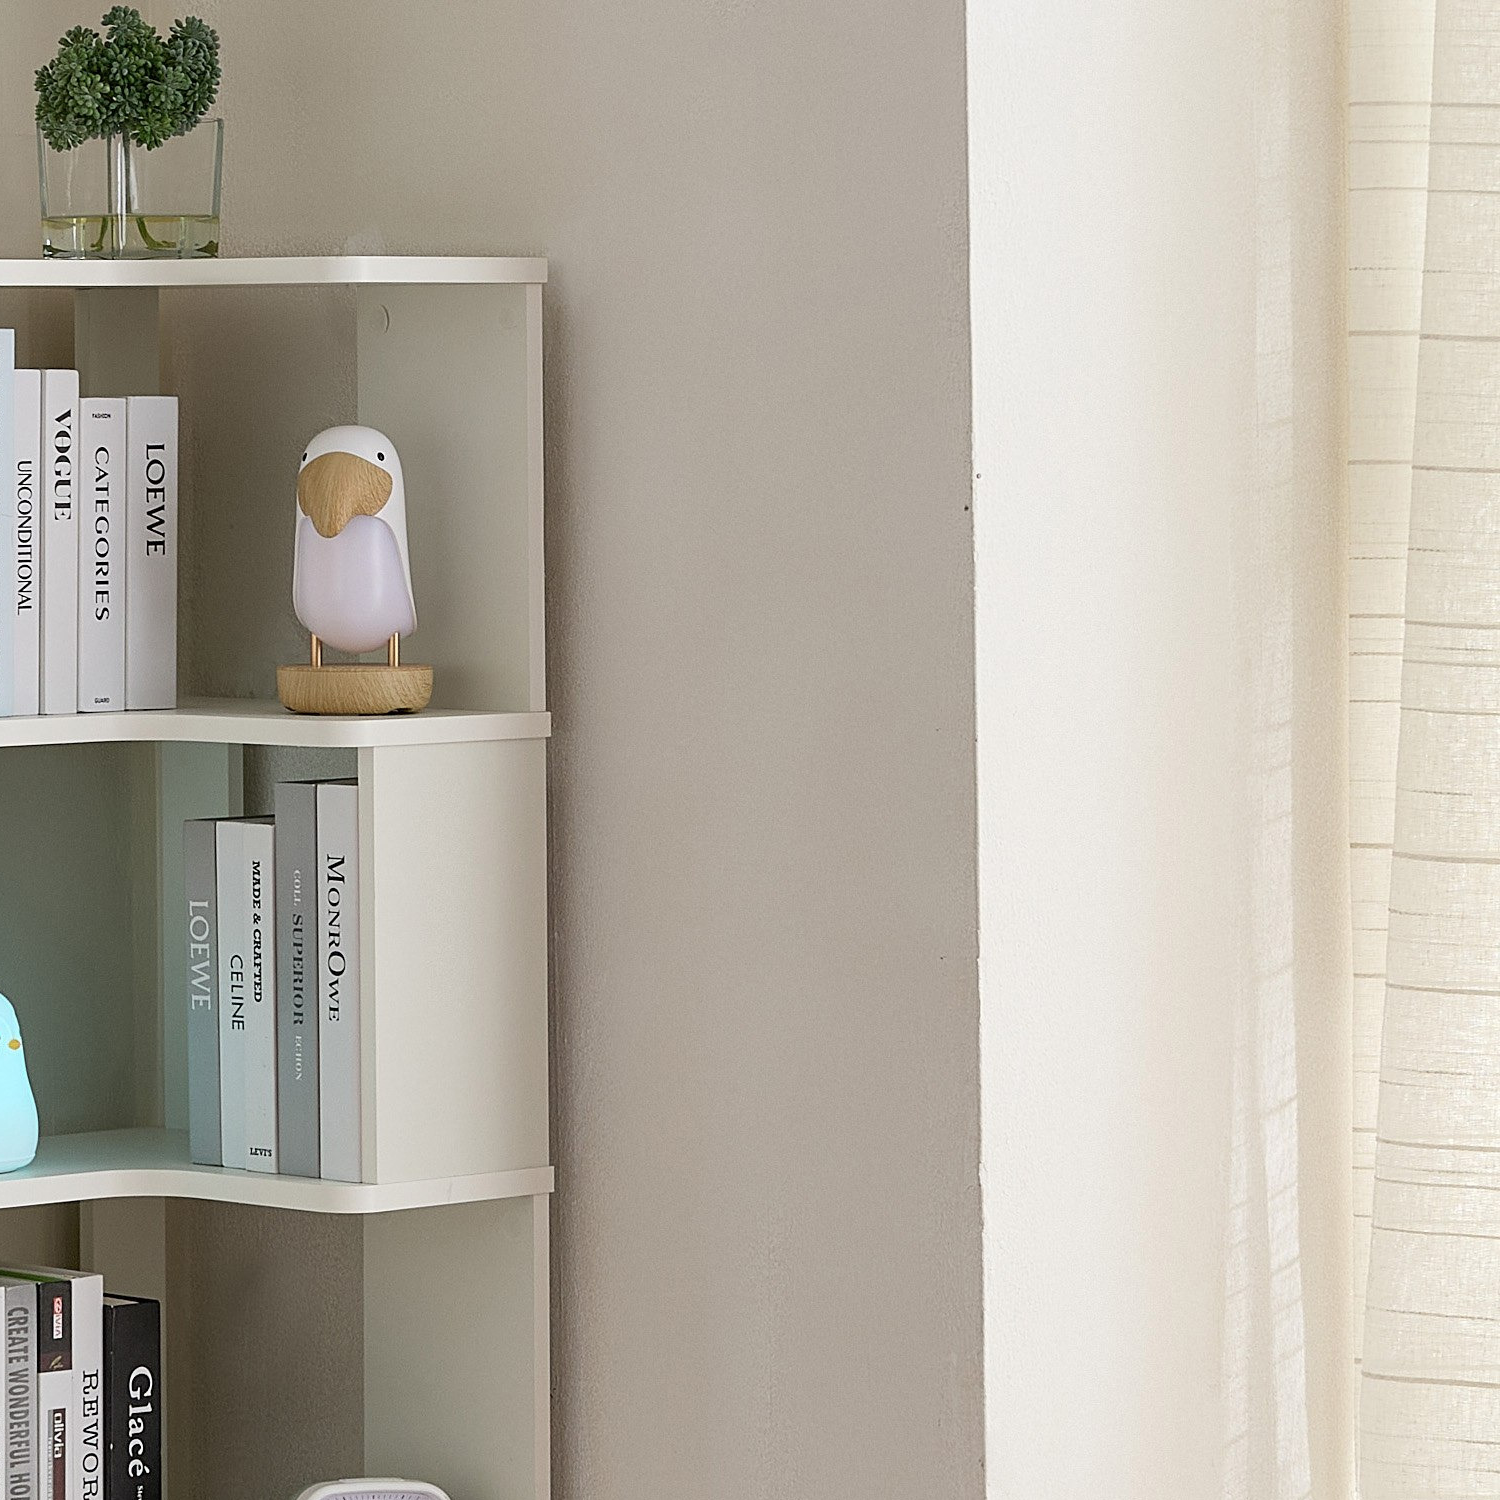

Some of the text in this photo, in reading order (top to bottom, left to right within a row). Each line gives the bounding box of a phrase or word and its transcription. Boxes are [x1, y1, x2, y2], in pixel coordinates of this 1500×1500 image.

[54, 408, 73, 521] VOGUE
[146, 443, 166, 556] LOEWE
[17, 460, 33, 615] UNCONDITIONAL
[94, 446, 110, 621] CATEGORIES
[189, 900, 211, 1011] LOEWE
[252, 860, 262, 1003] MADE & CRAFTED
[292, 913, 304, 1025] SUPERIOR
[230, 954, 245, 1031] CELINE
[7, 1306, 29, 1364] CREATE
[8, 1368, 31, 1468] WONDERFUL
[53, 1412, 64, 1459] olivia
[128, 1366, 154, 1478] Glacé
